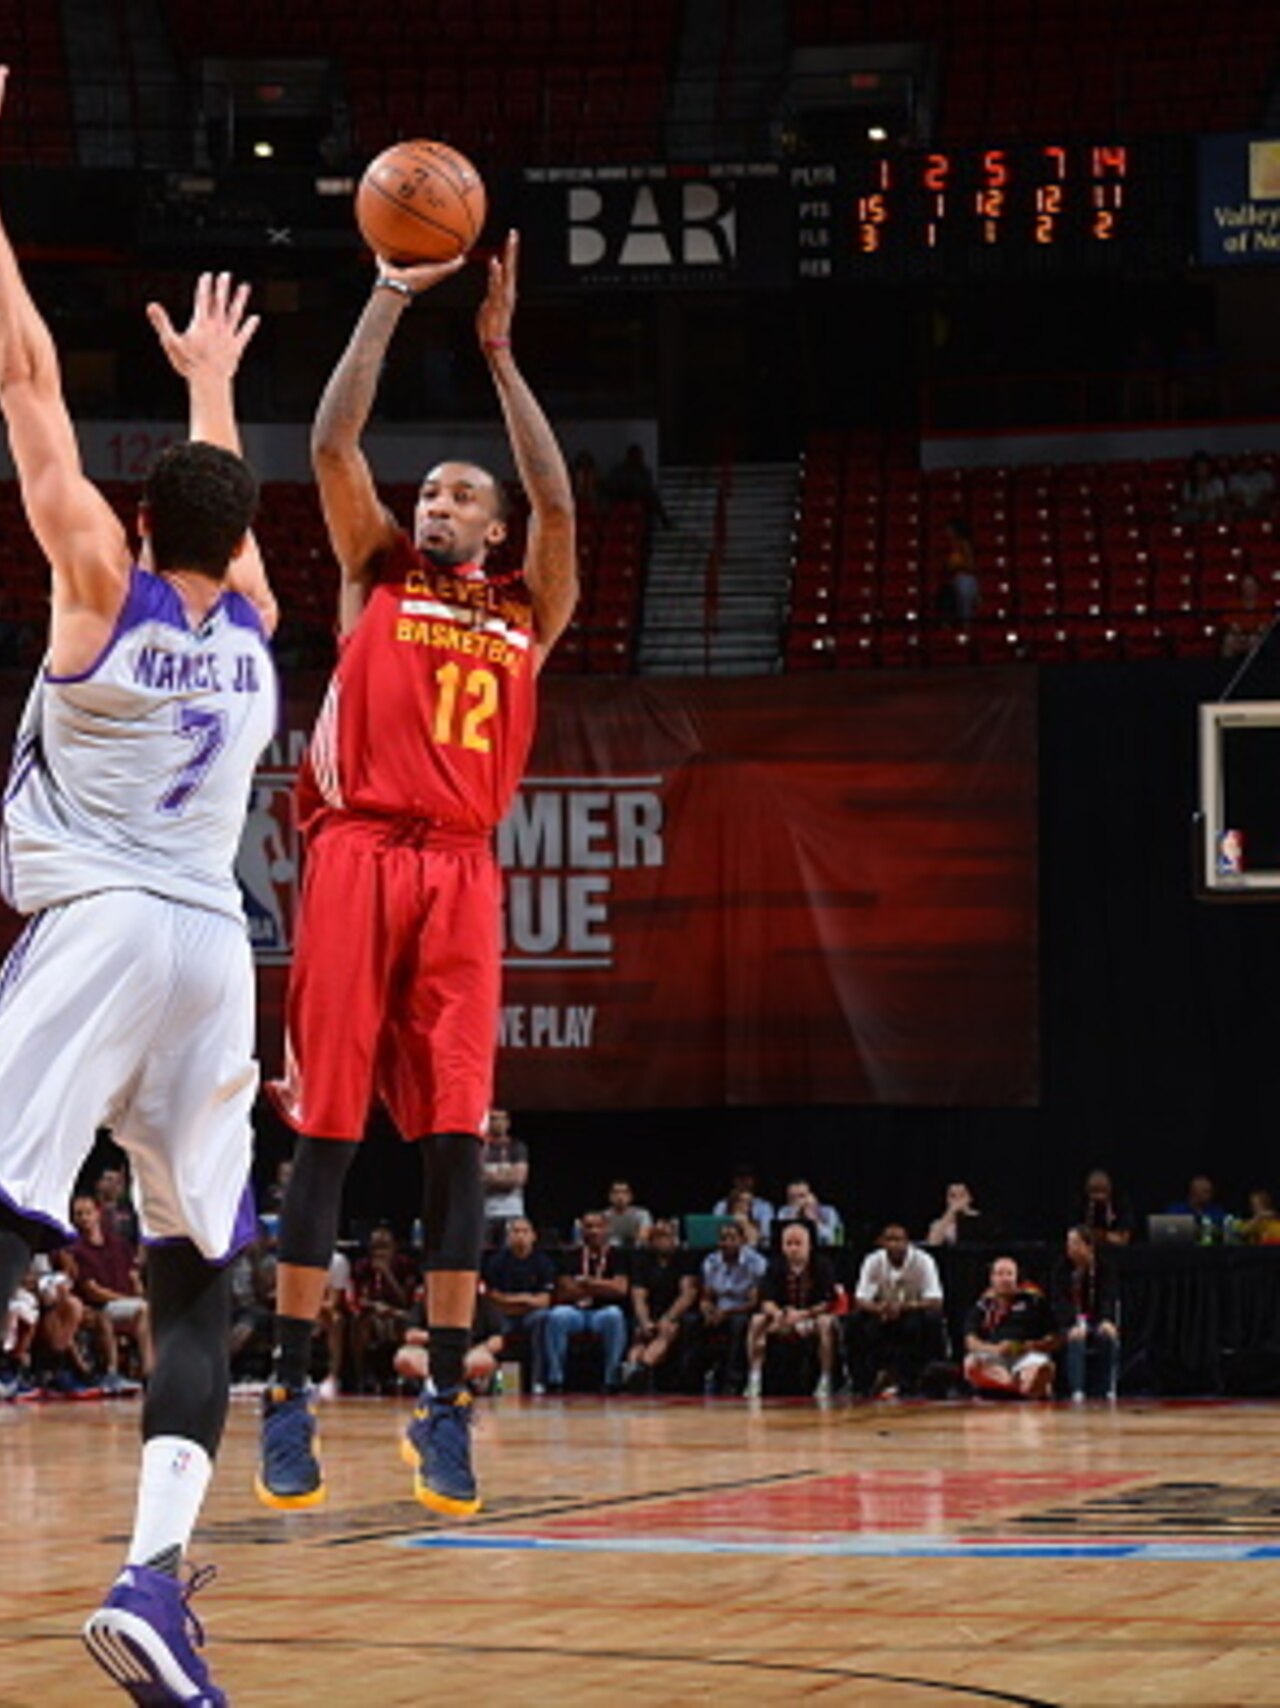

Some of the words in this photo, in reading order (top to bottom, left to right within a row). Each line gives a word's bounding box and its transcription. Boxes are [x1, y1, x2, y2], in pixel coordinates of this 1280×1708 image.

[924, 154, 949, 190] 2
[984, 150, 1007, 187] 5
[1044, 147, 1066, 180] 7
[1093, 146, 1127, 178] 14
[858, 193, 887, 223] 15
[975, 188, 1004, 218] 12
[1036, 183, 1062, 214] 12
[1213, 203, 1280, 233] Valley
[860, 222, 879, 253] 3
[1036, 214, 1054, 244] 2
[1094, 210, 1114, 240] 2
[1222, 231, 1250, 253] of
[133, 646, 222, 692] NANCE
[433, 661, 498, 752] 12
[154, 704, 227, 817] 7
[497, 791, 664, 868] MER
[500, 875, 612, 952] UE
[531, 1004, 596, 1048] PLAY
